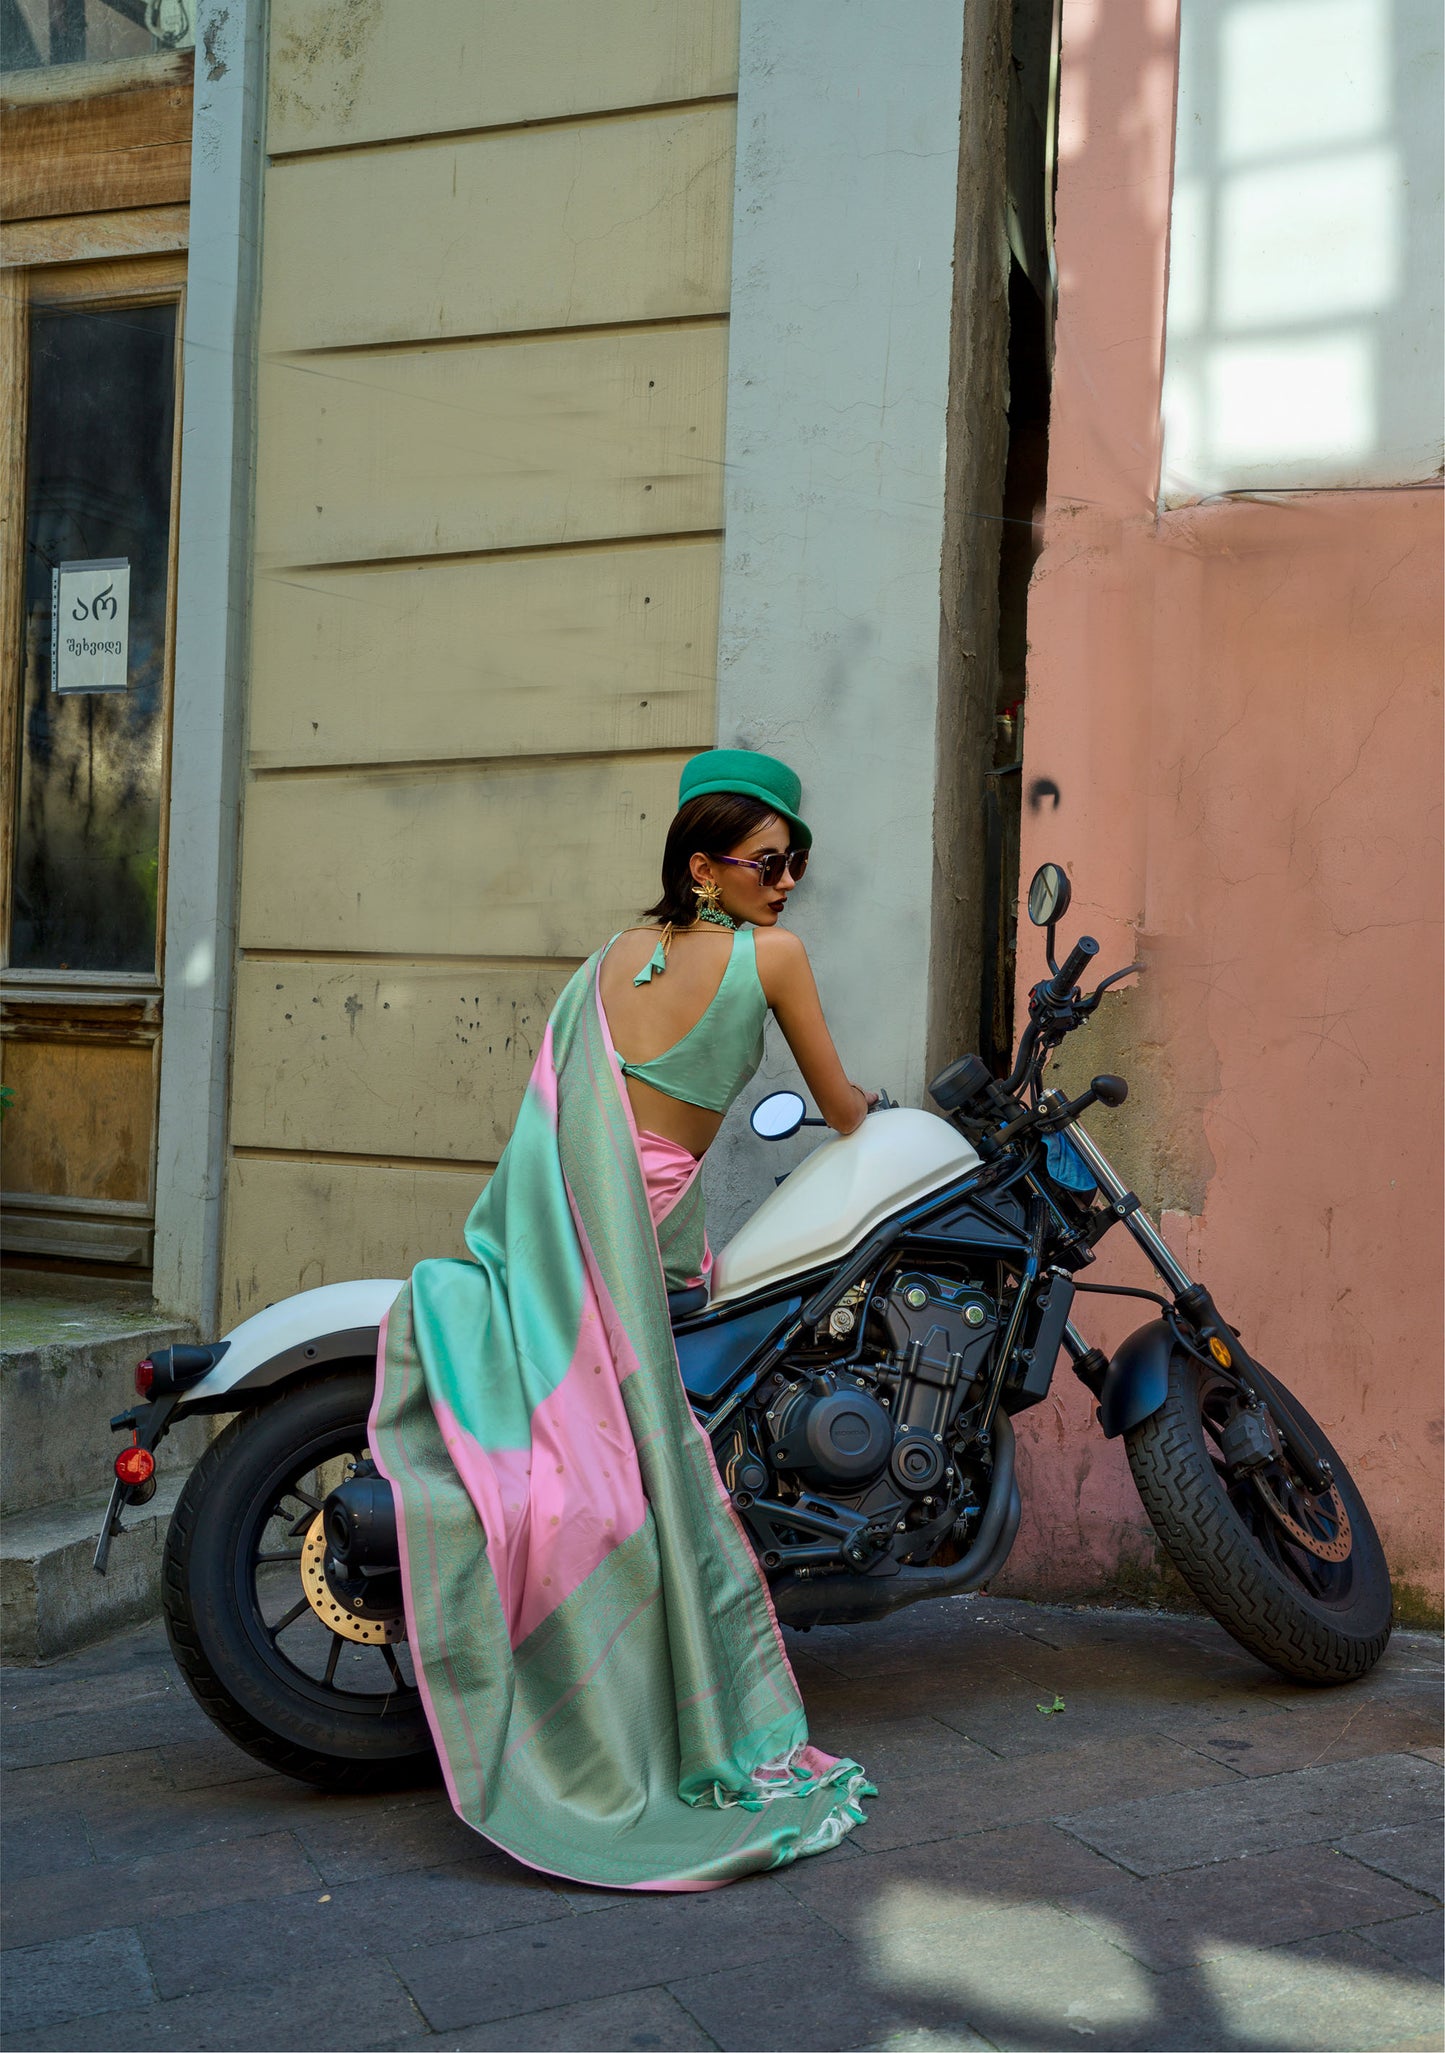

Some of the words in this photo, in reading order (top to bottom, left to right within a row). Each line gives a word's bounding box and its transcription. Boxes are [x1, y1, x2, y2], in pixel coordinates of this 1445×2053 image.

[72, 583, 118, 621] არ
[66, 638, 122, 656] შეხვიდე
[834, 1429, 866, 1437] HONDA
